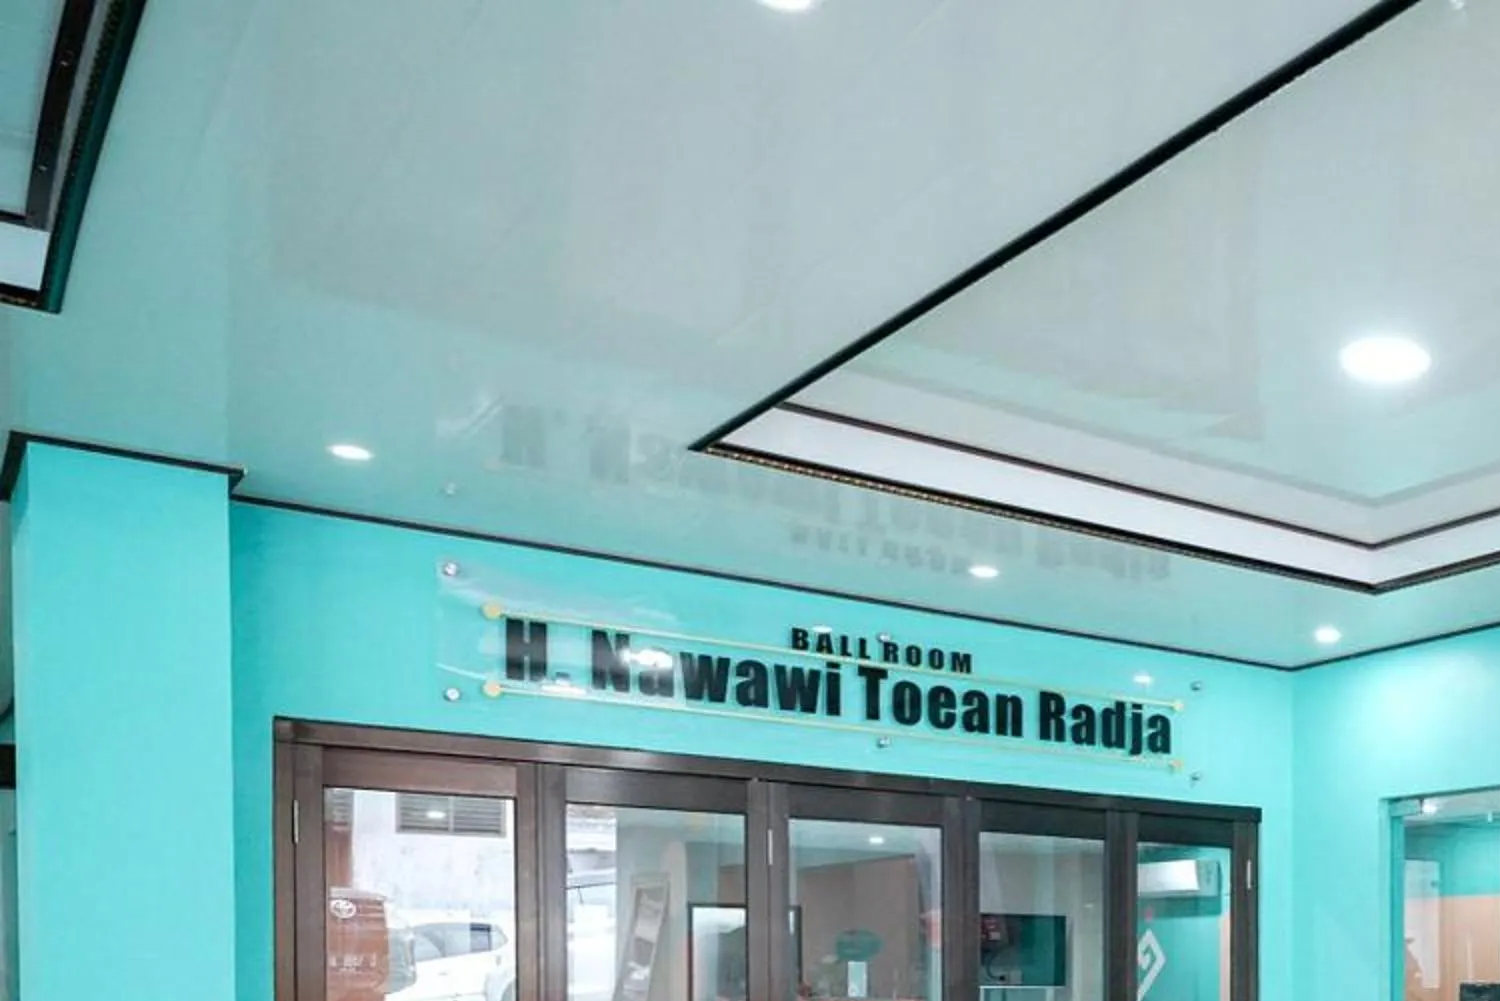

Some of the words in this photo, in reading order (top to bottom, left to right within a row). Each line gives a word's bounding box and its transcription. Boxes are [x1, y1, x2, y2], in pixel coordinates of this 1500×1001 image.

[591, 629, 842, 716] Nawawi
[857, 665, 1024, 738] Toean
[1038, 690, 1172, 755] Radja
[791, 627, 871, 660] BALL
[883, 641, 972, 674] ROOM
